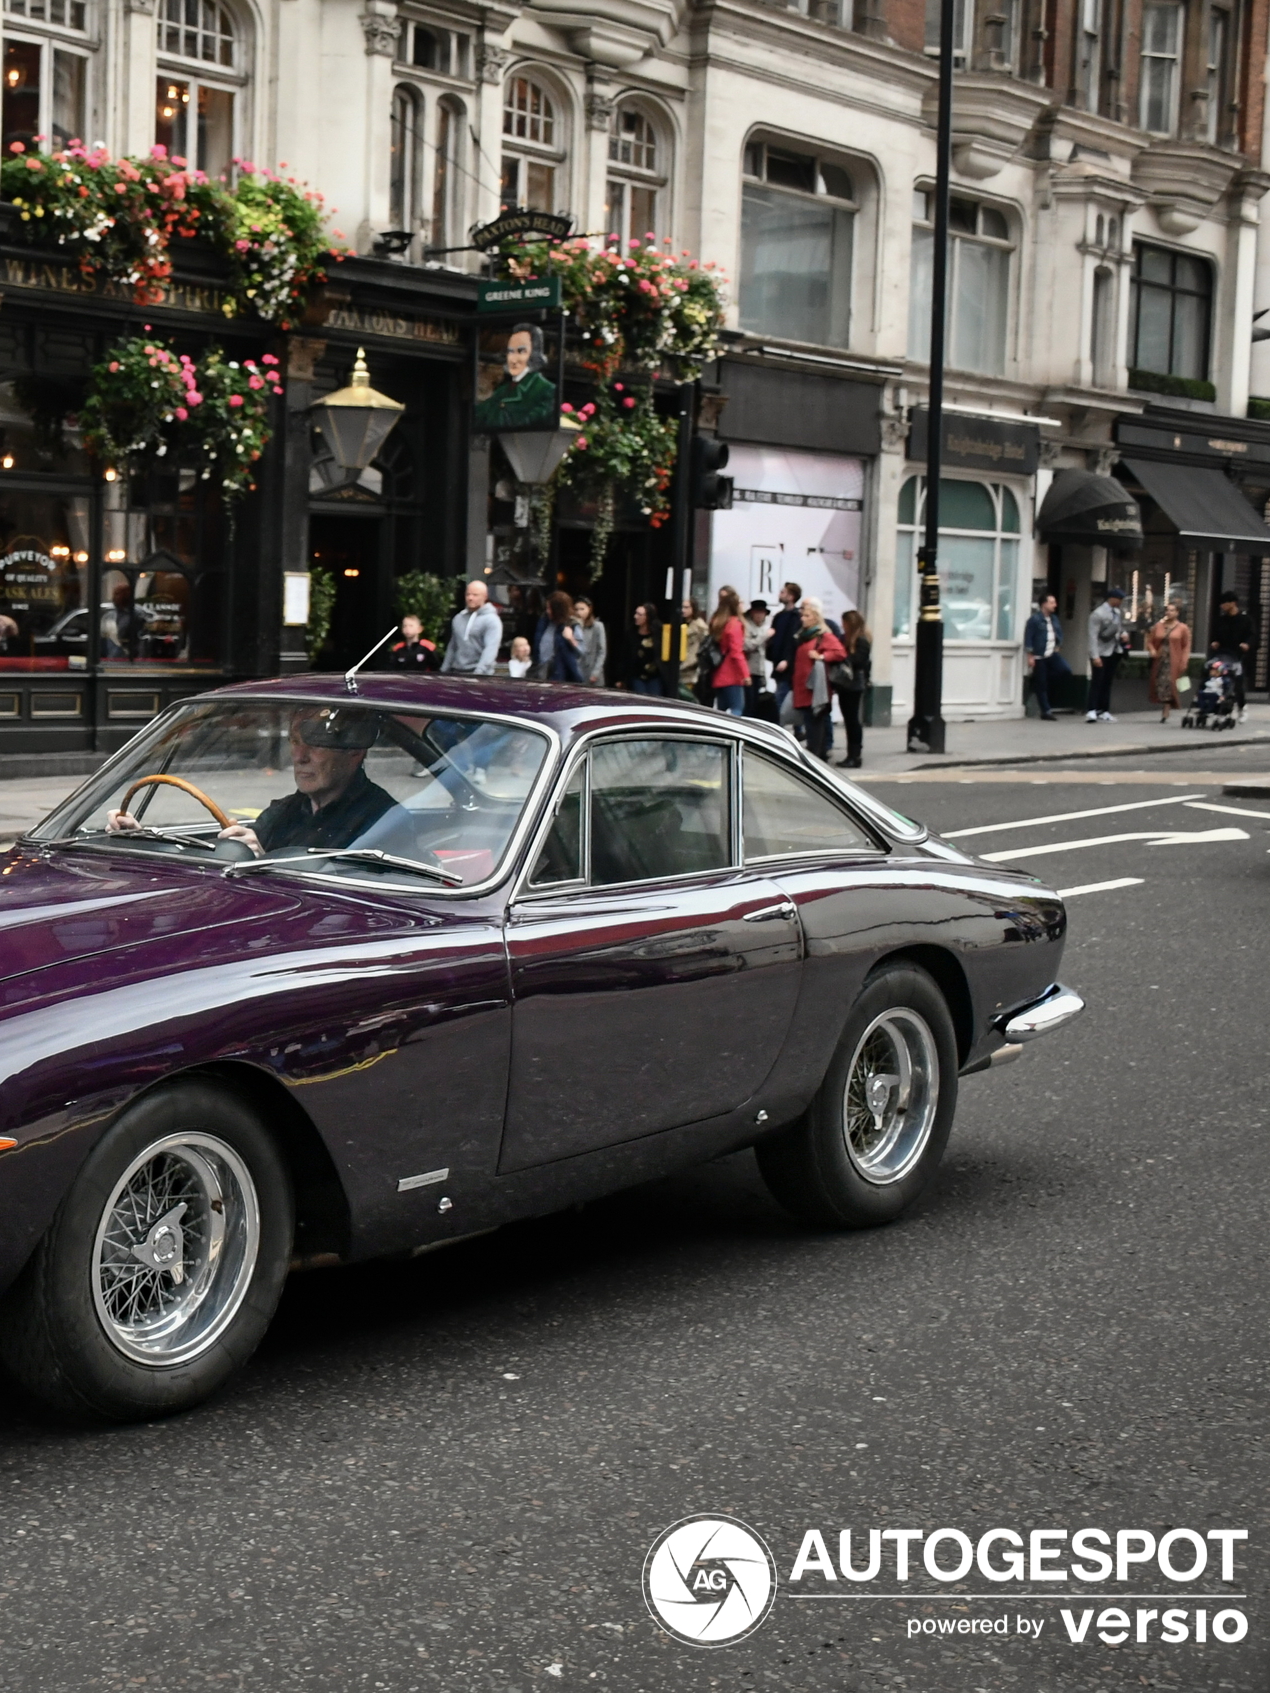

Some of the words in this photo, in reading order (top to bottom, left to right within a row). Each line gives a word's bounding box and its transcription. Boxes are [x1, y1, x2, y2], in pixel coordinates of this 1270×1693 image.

[532, 217, 566, 236] HEAD
[4, 258, 97, 293] WINES
[485, 289, 523, 302] GREENE
[525, 287, 550, 298] KING
[5, 573, 15, 582] OF
[16, 574, 48, 583] QUALITY
[759, 559, 773, 594] R
